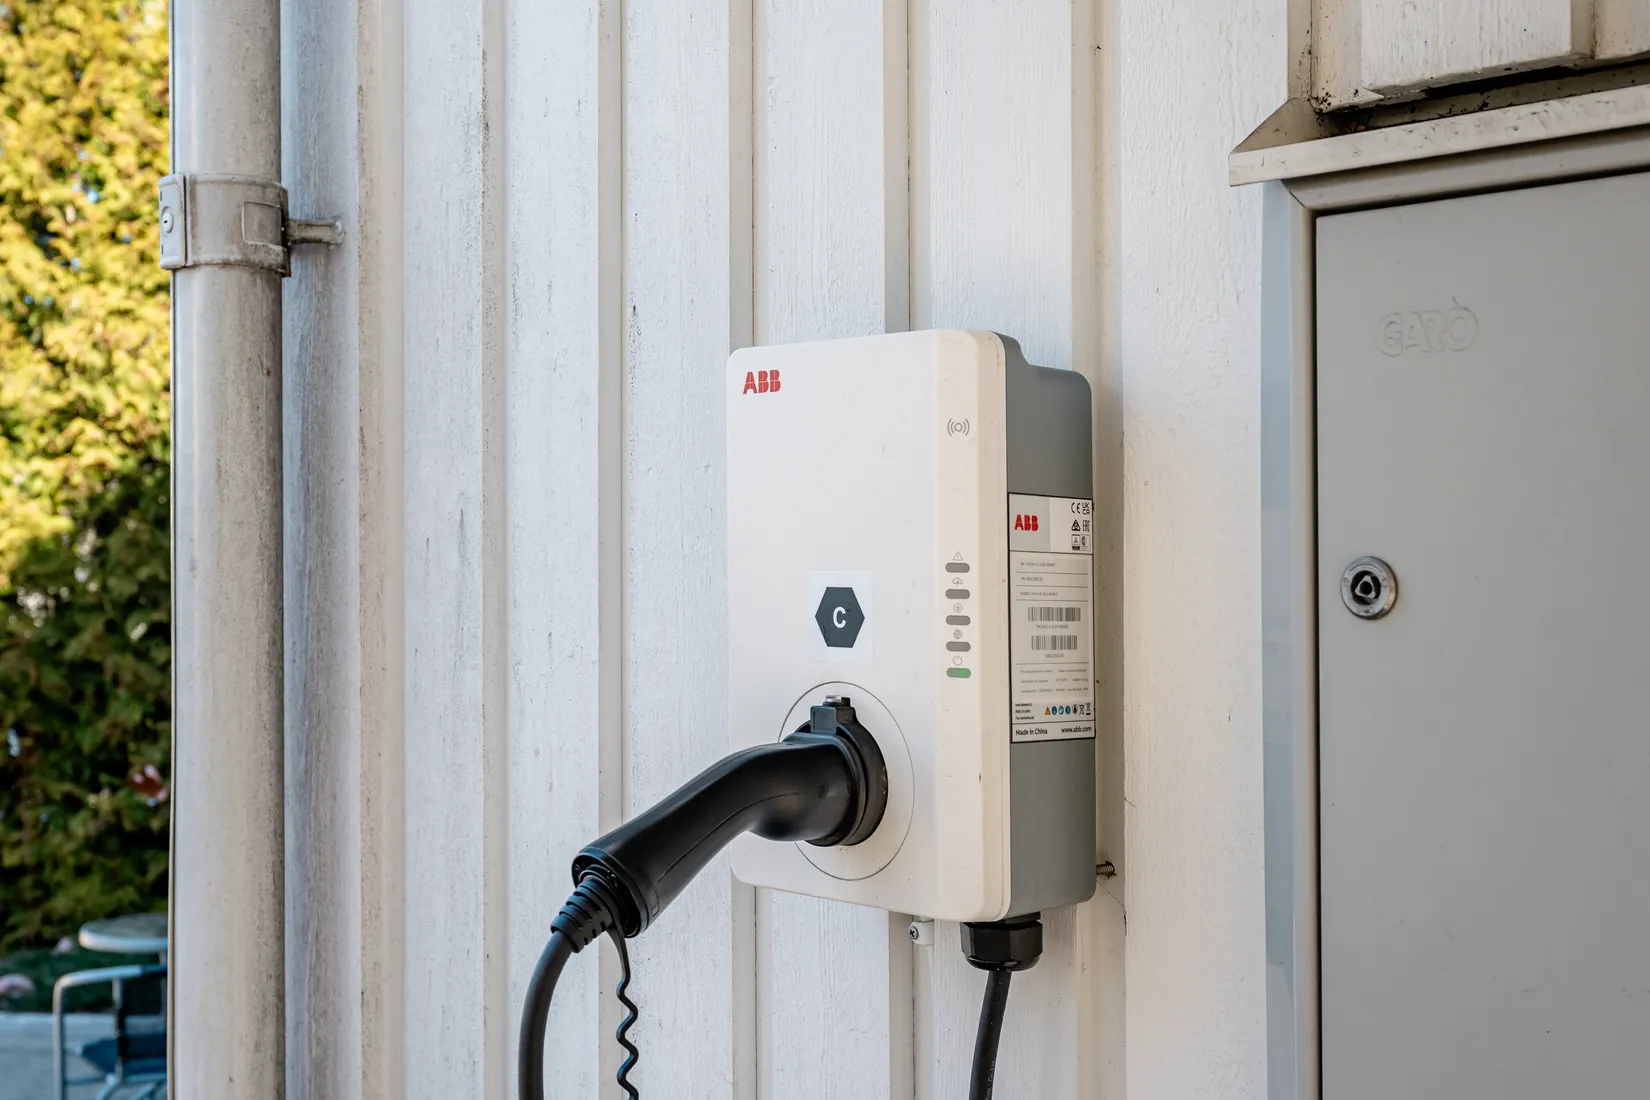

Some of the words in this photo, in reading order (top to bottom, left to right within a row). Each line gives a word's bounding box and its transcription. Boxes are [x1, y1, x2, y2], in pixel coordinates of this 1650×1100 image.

[742, 369, 781, 395] ABB
[1014, 514, 1039, 531] ABB
[833, 606, 847, 629] C
[1061, 725, 1092, 733] www.abb.com
